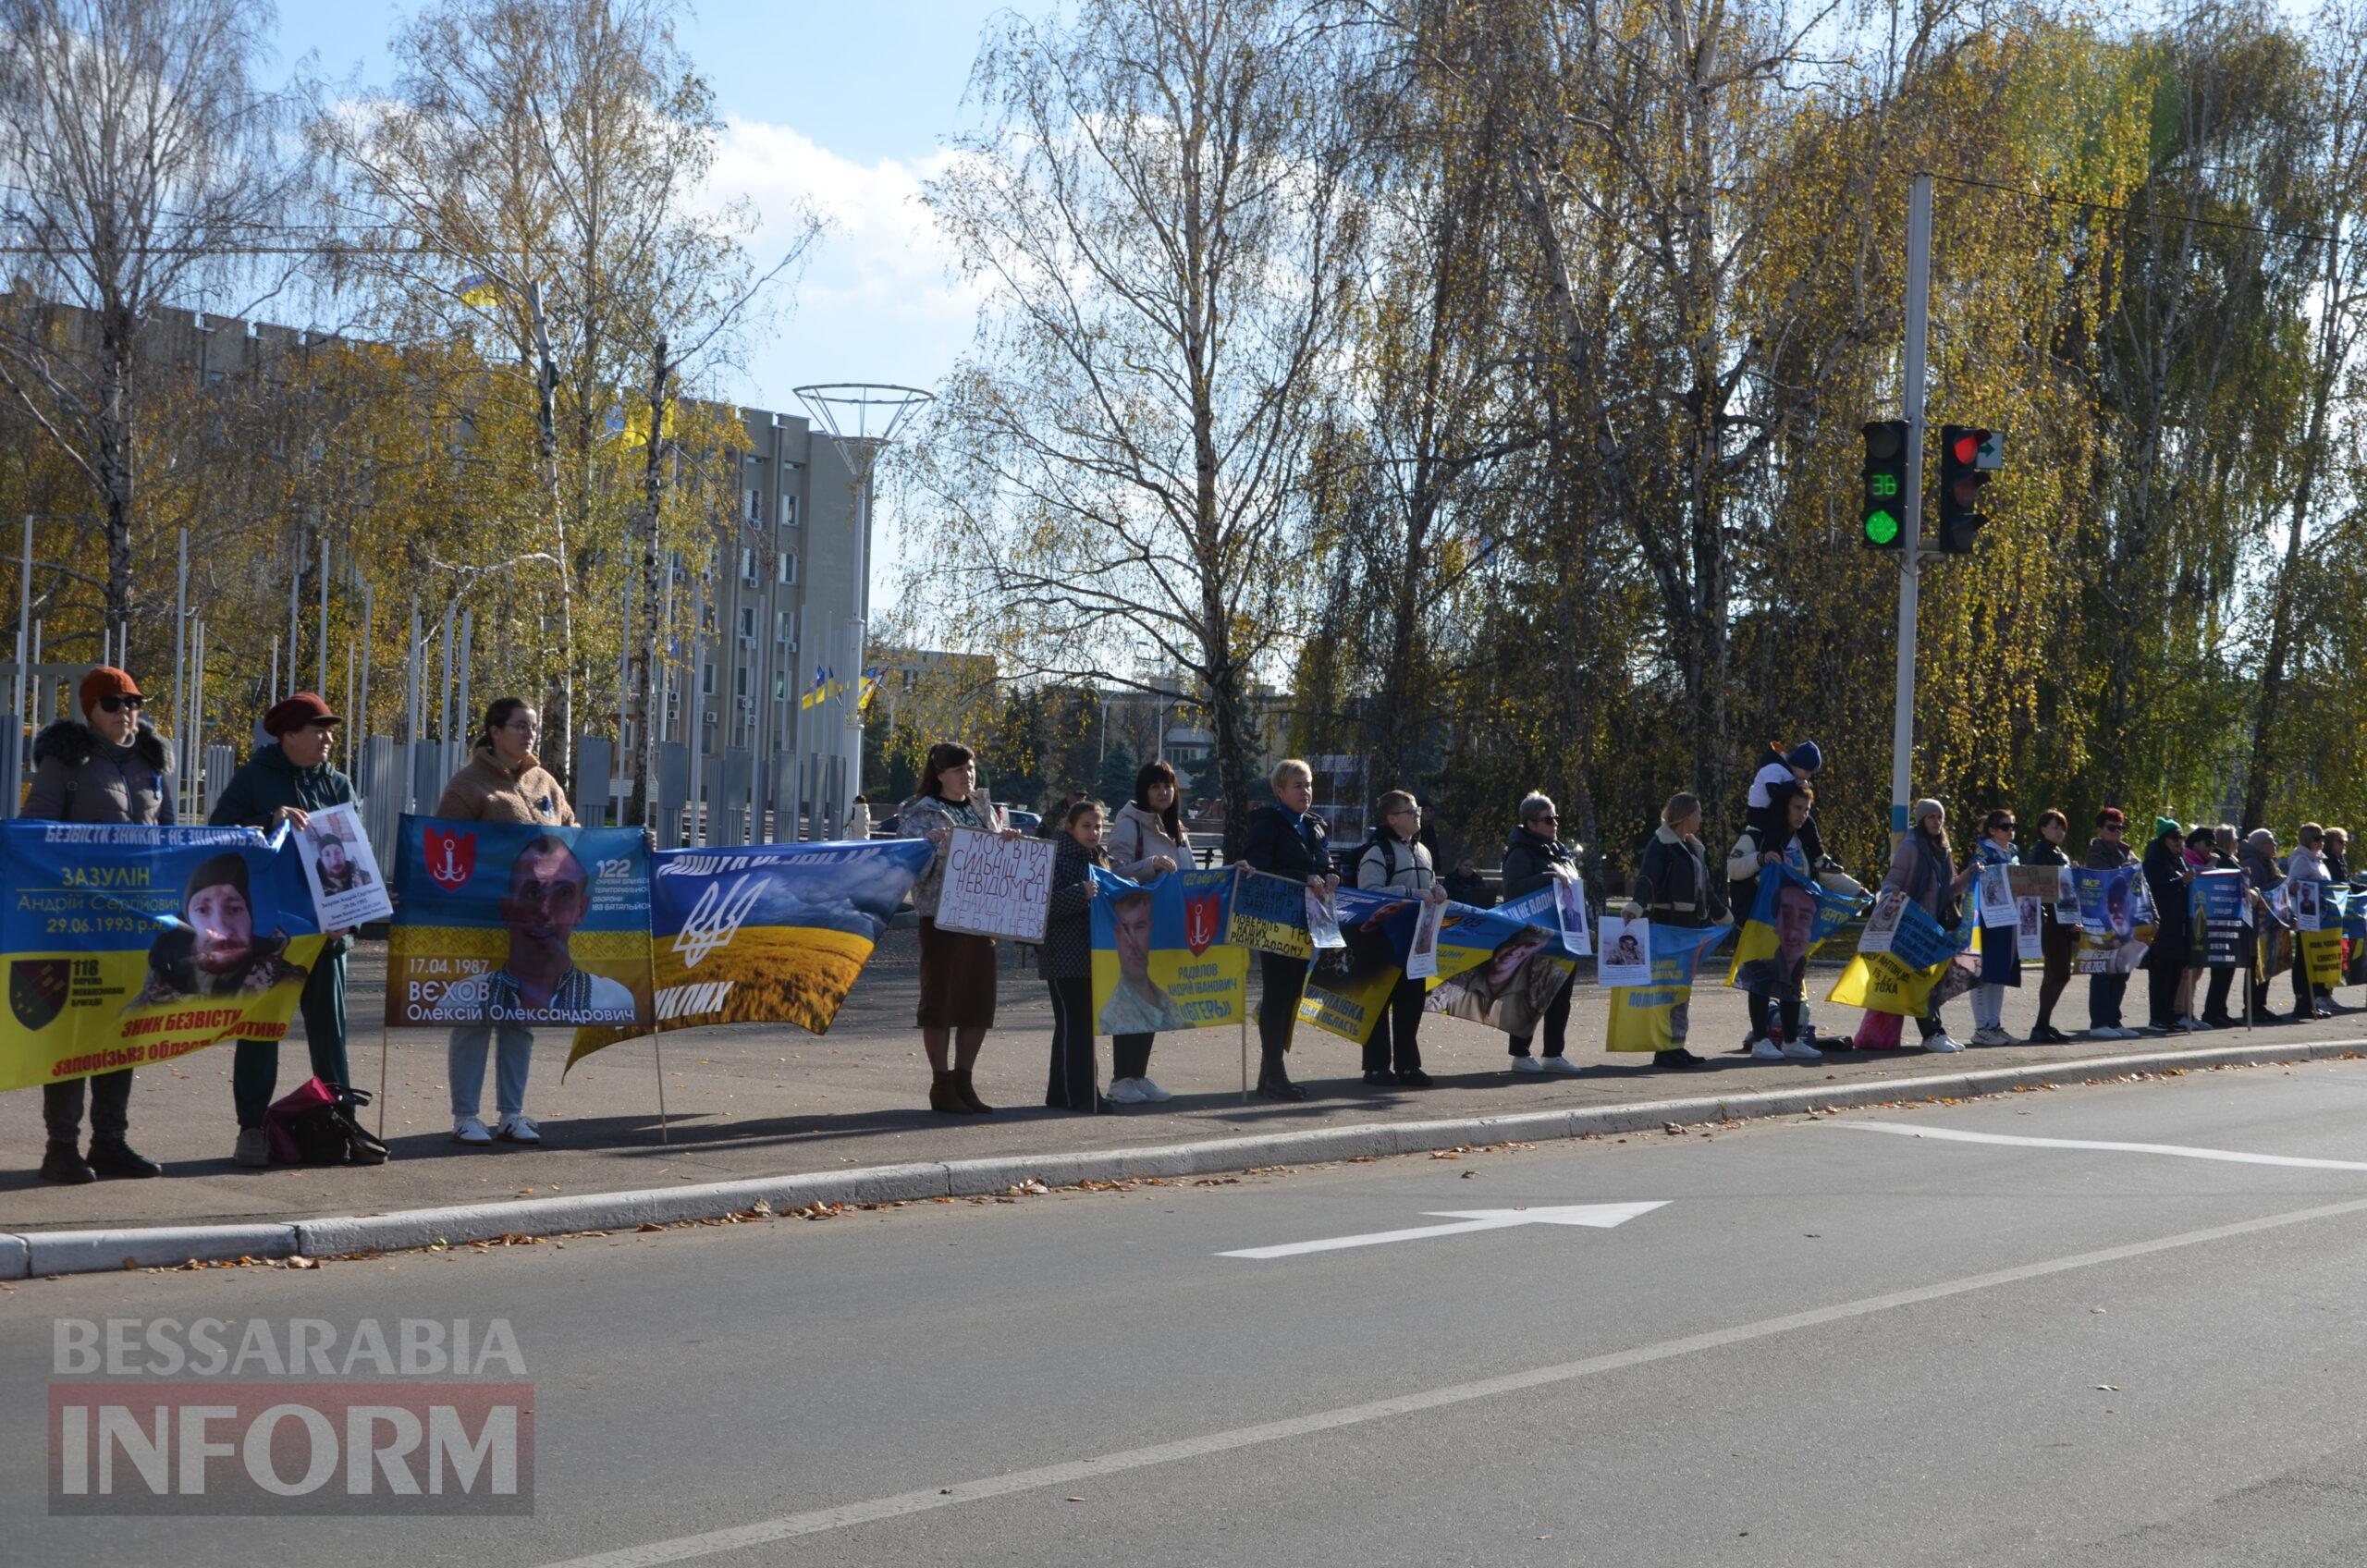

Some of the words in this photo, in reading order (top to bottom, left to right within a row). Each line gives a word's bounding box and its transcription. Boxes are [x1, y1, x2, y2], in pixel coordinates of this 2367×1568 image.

[45, 825, 109, 844] БЕЗВІСТИ
[168, 828, 186, 846] НЕ
[969, 833, 1005, 856] МОЯ
[1013, 839, 1049, 863] ВІРА
[61, 867, 151, 886] ЗАЗУЛІН
[596, 859, 631, 877] 122
[952, 850, 1020, 878] СИЛЬНІШ
[1024, 862, 1046, 884] ЗА
[17, 893, 83, 911] Андрій
[89, 893, 179, 911] Сергійович
[1528, 891, 1555, 914] ВДОМ
[47, 918, 134, 933] 29.06.1993
[1233, 913, 1280, 932] ПОВЕРНІТЬ
[1238, 925, 1268, 941] НАШИХ
[1230, 931, 1260, 948] РІДНИХ
[1262, 939, 1304, 956] ДОДОМУ
[72, 960, 100, 976] 118
[409, 959, 490, 974] 17.04.1987
[409, 981, 490, 1001] ВЄХОВ
[407, 1004, 483, 1021] Олексій
[489, 1004, 636, 1023] Олександрович
[1299, 1001, 1321, 1021] ЦЬКА
[121, 1015, 163, 1037] ЗНИК
[165, 1009, 243, 1032] БЕЗВІСТИ
[52, 1045, 144, 1077] запорізька
